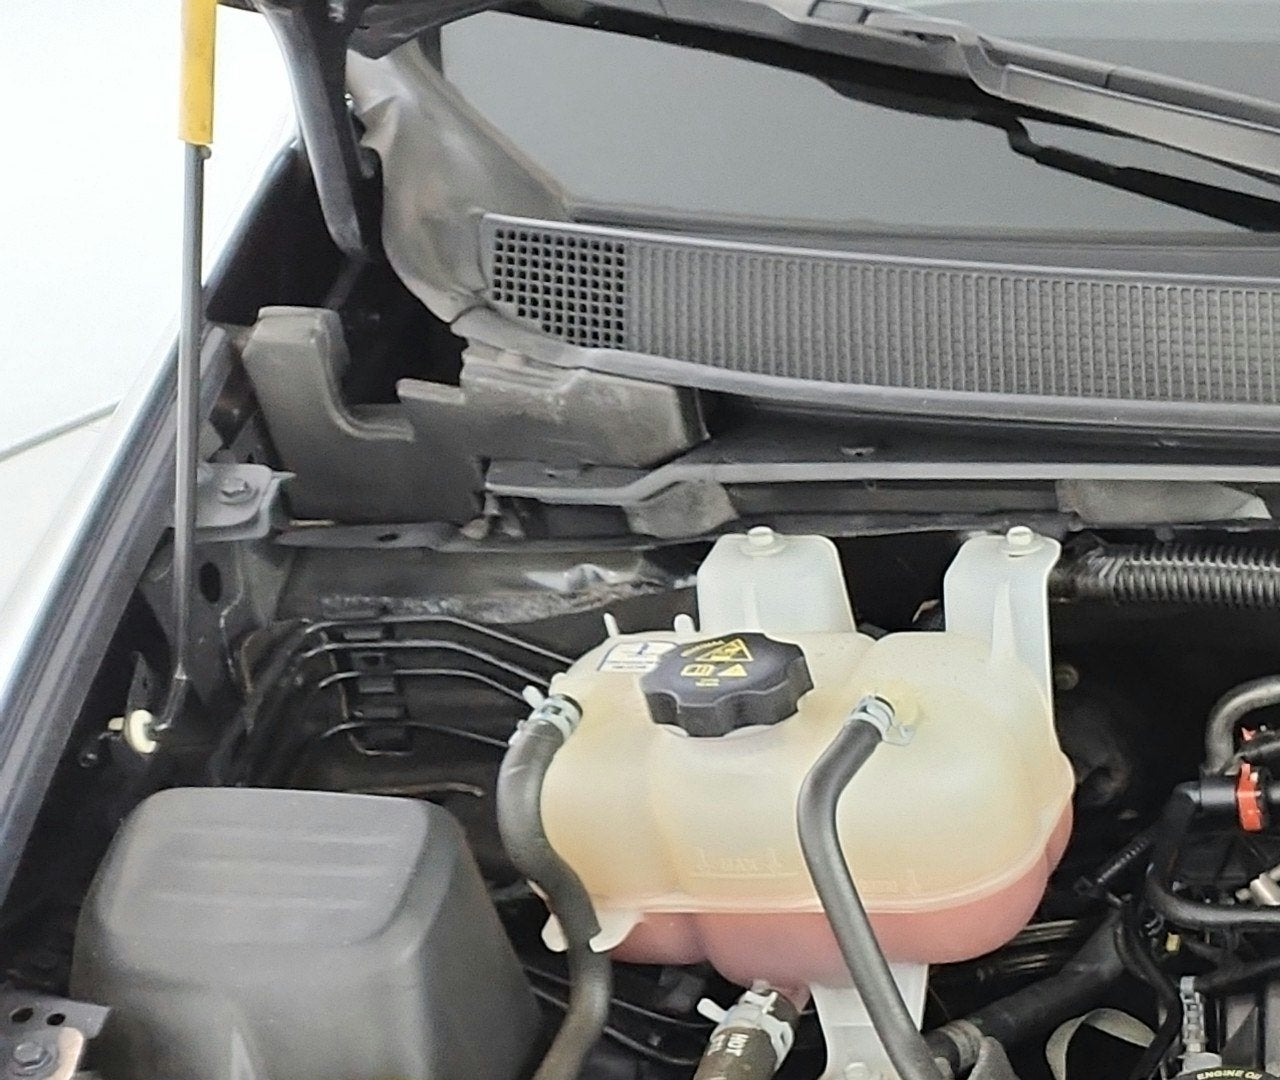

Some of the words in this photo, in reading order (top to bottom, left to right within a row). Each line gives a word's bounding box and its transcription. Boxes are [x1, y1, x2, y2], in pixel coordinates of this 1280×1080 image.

[725, 1033, 749, 1057] HOT
[1196, 1069, 1244, 1080] ENGINE
[1244, 1071, 1263, 1080] OIL
